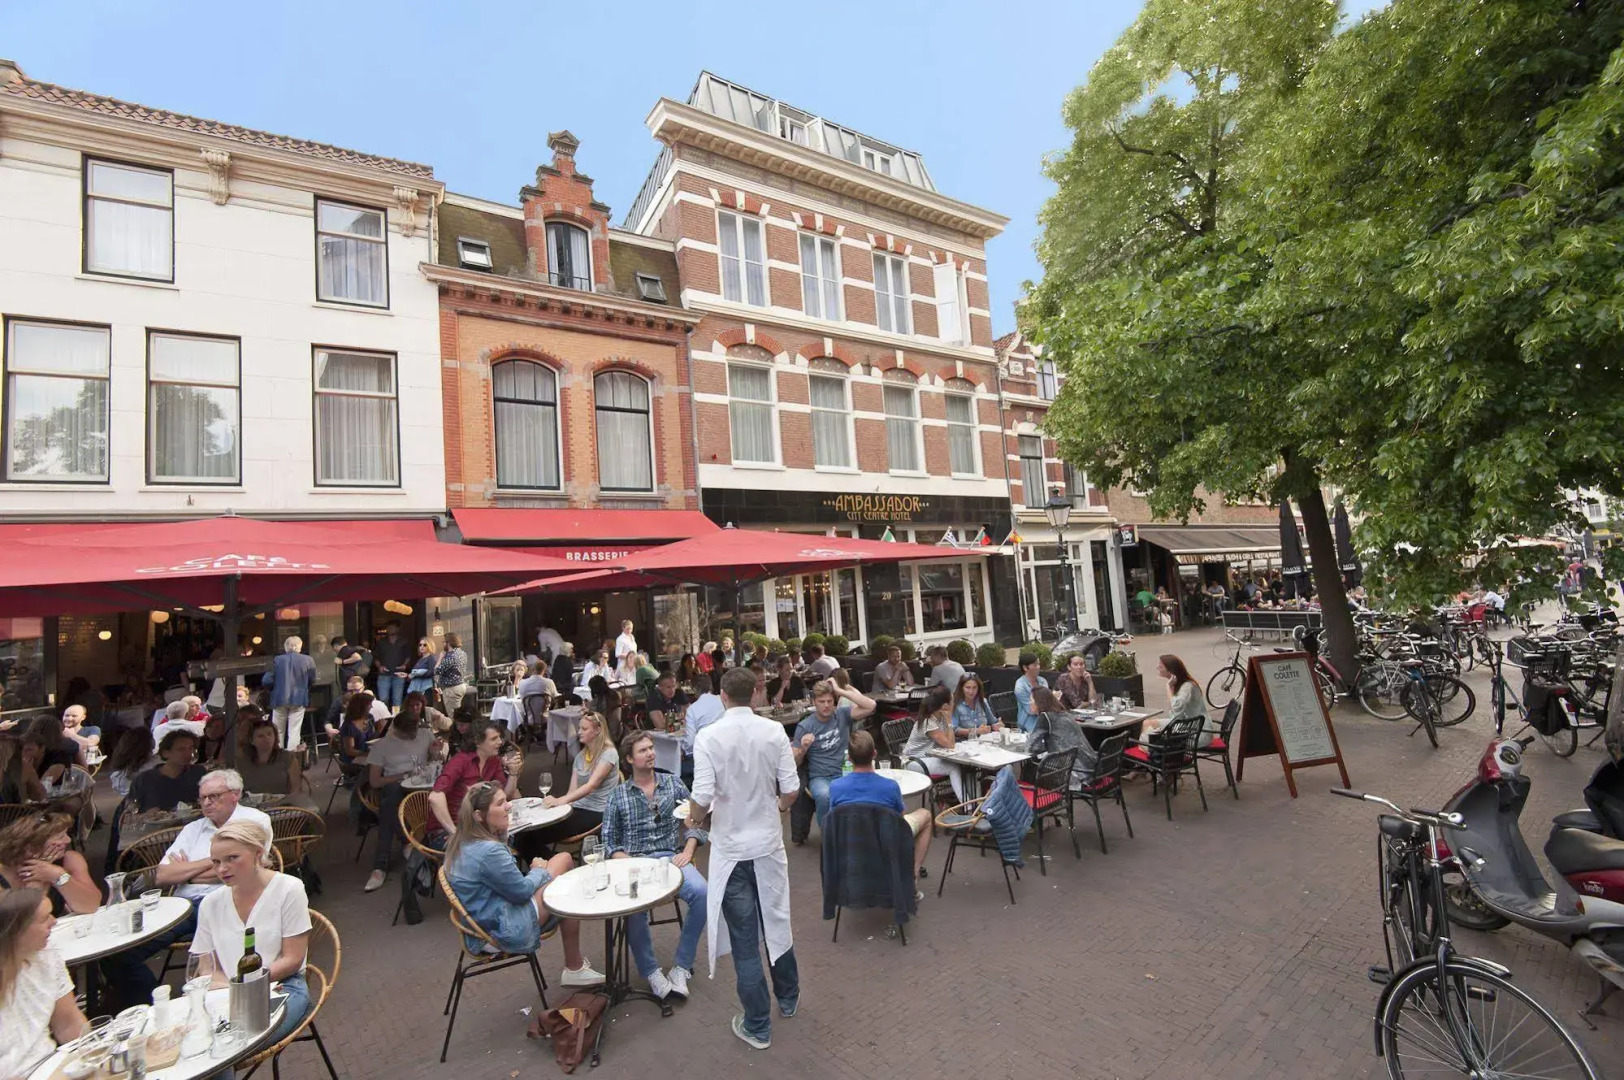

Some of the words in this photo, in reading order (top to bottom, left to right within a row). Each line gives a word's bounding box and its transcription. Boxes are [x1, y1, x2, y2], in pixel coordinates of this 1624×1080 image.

[835, 494, 920, 512] AMBASSADOR
[846, 511, 861, 520] CITY
[863, 511, 889, 520] CENTRE
[890, 511, 911, 520] HOTEL
[1274, 671, 1300, 680] COLETTE
